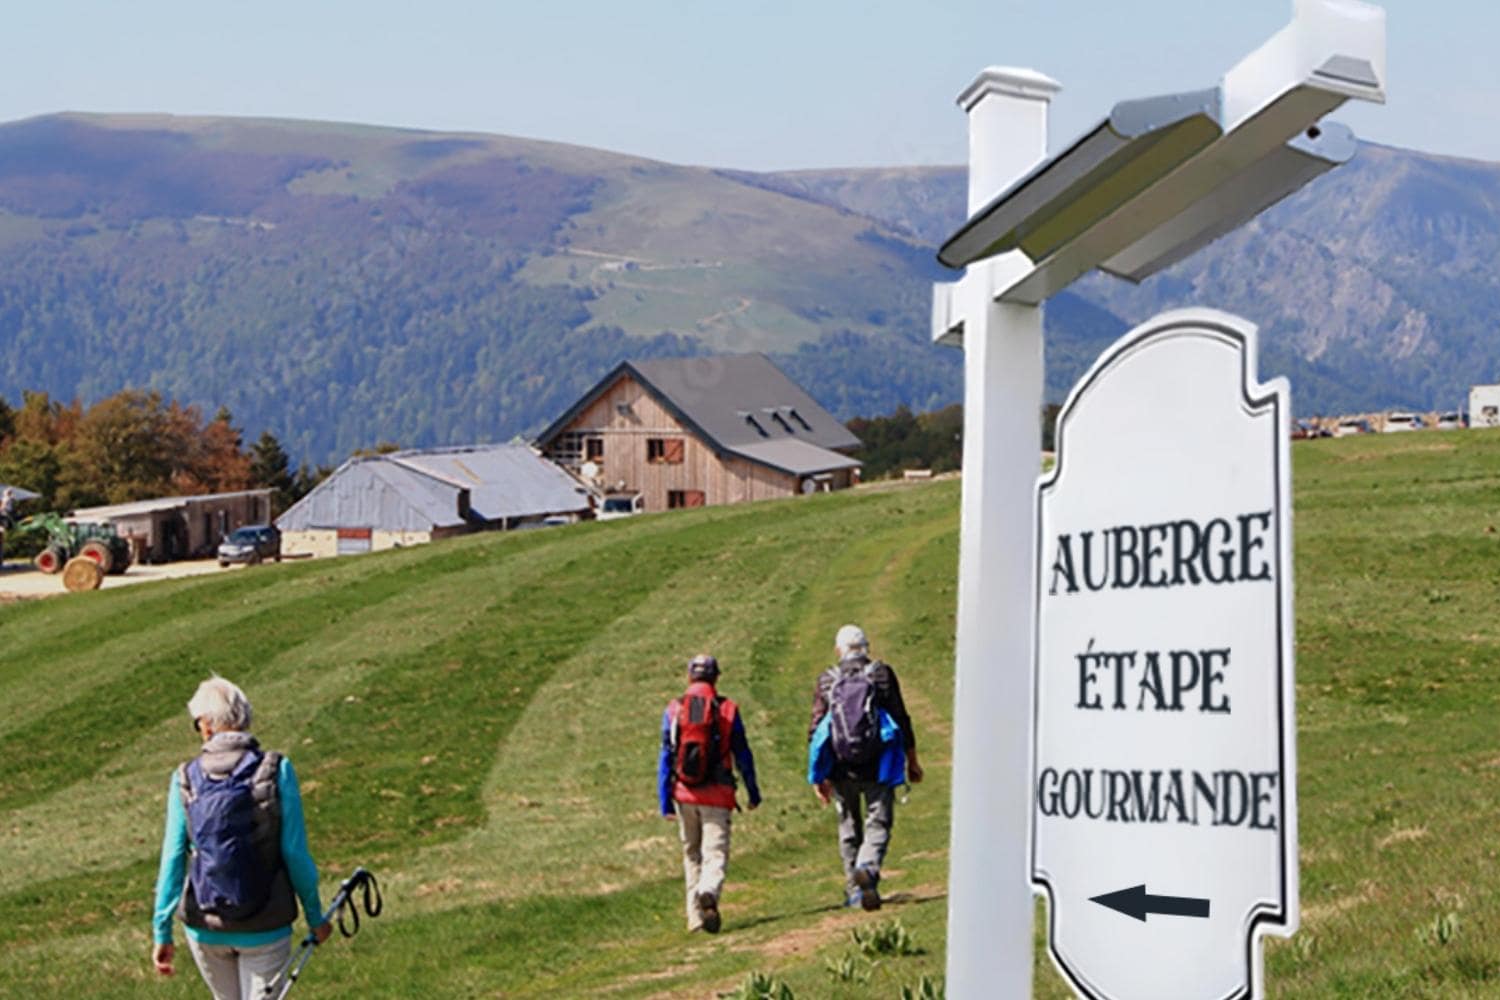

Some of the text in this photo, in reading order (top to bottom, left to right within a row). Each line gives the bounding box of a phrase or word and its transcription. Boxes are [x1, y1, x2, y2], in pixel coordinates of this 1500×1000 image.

[1050, 511, 1272, 595] AUBERGE
[1075, 638, 1231, 714] ÉTAPE
[1038, 767, 1279, 831] GOURMANDE
